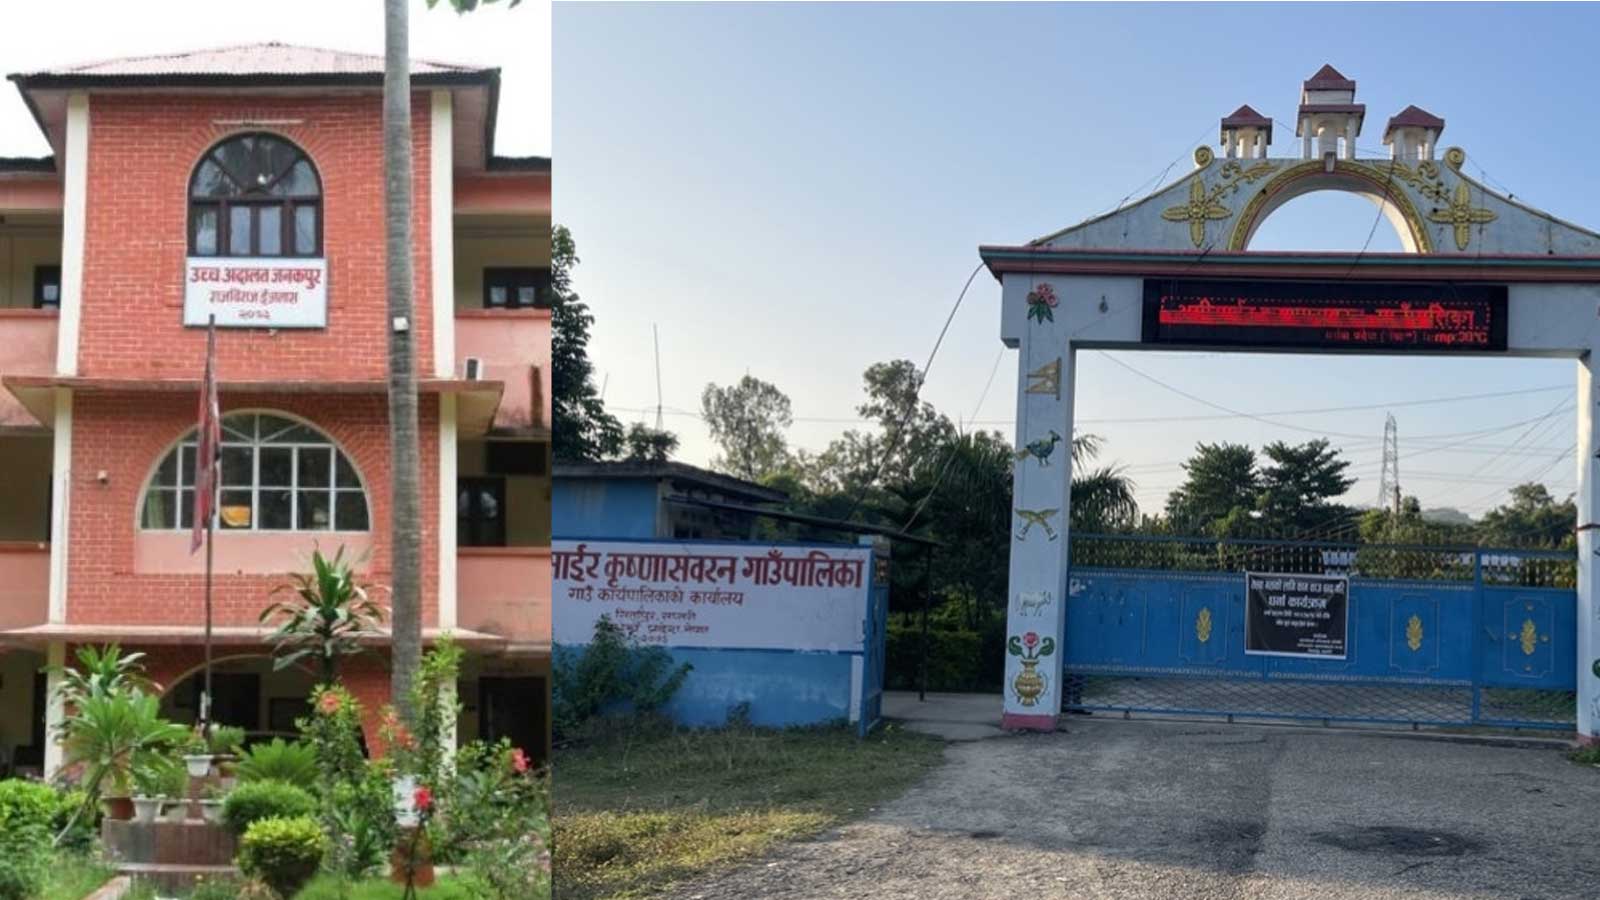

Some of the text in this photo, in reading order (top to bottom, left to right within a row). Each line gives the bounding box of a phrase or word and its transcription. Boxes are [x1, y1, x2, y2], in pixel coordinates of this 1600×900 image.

[222, 266, 269, 285] अदालत
[270, 267, 321, 289] जनकपुर
[604, 552, 738, 588] कृष्णासवरन
[742, 549, 866, 588] गाउँपालिका
[688, 586, 744, 606] कार्यालय
